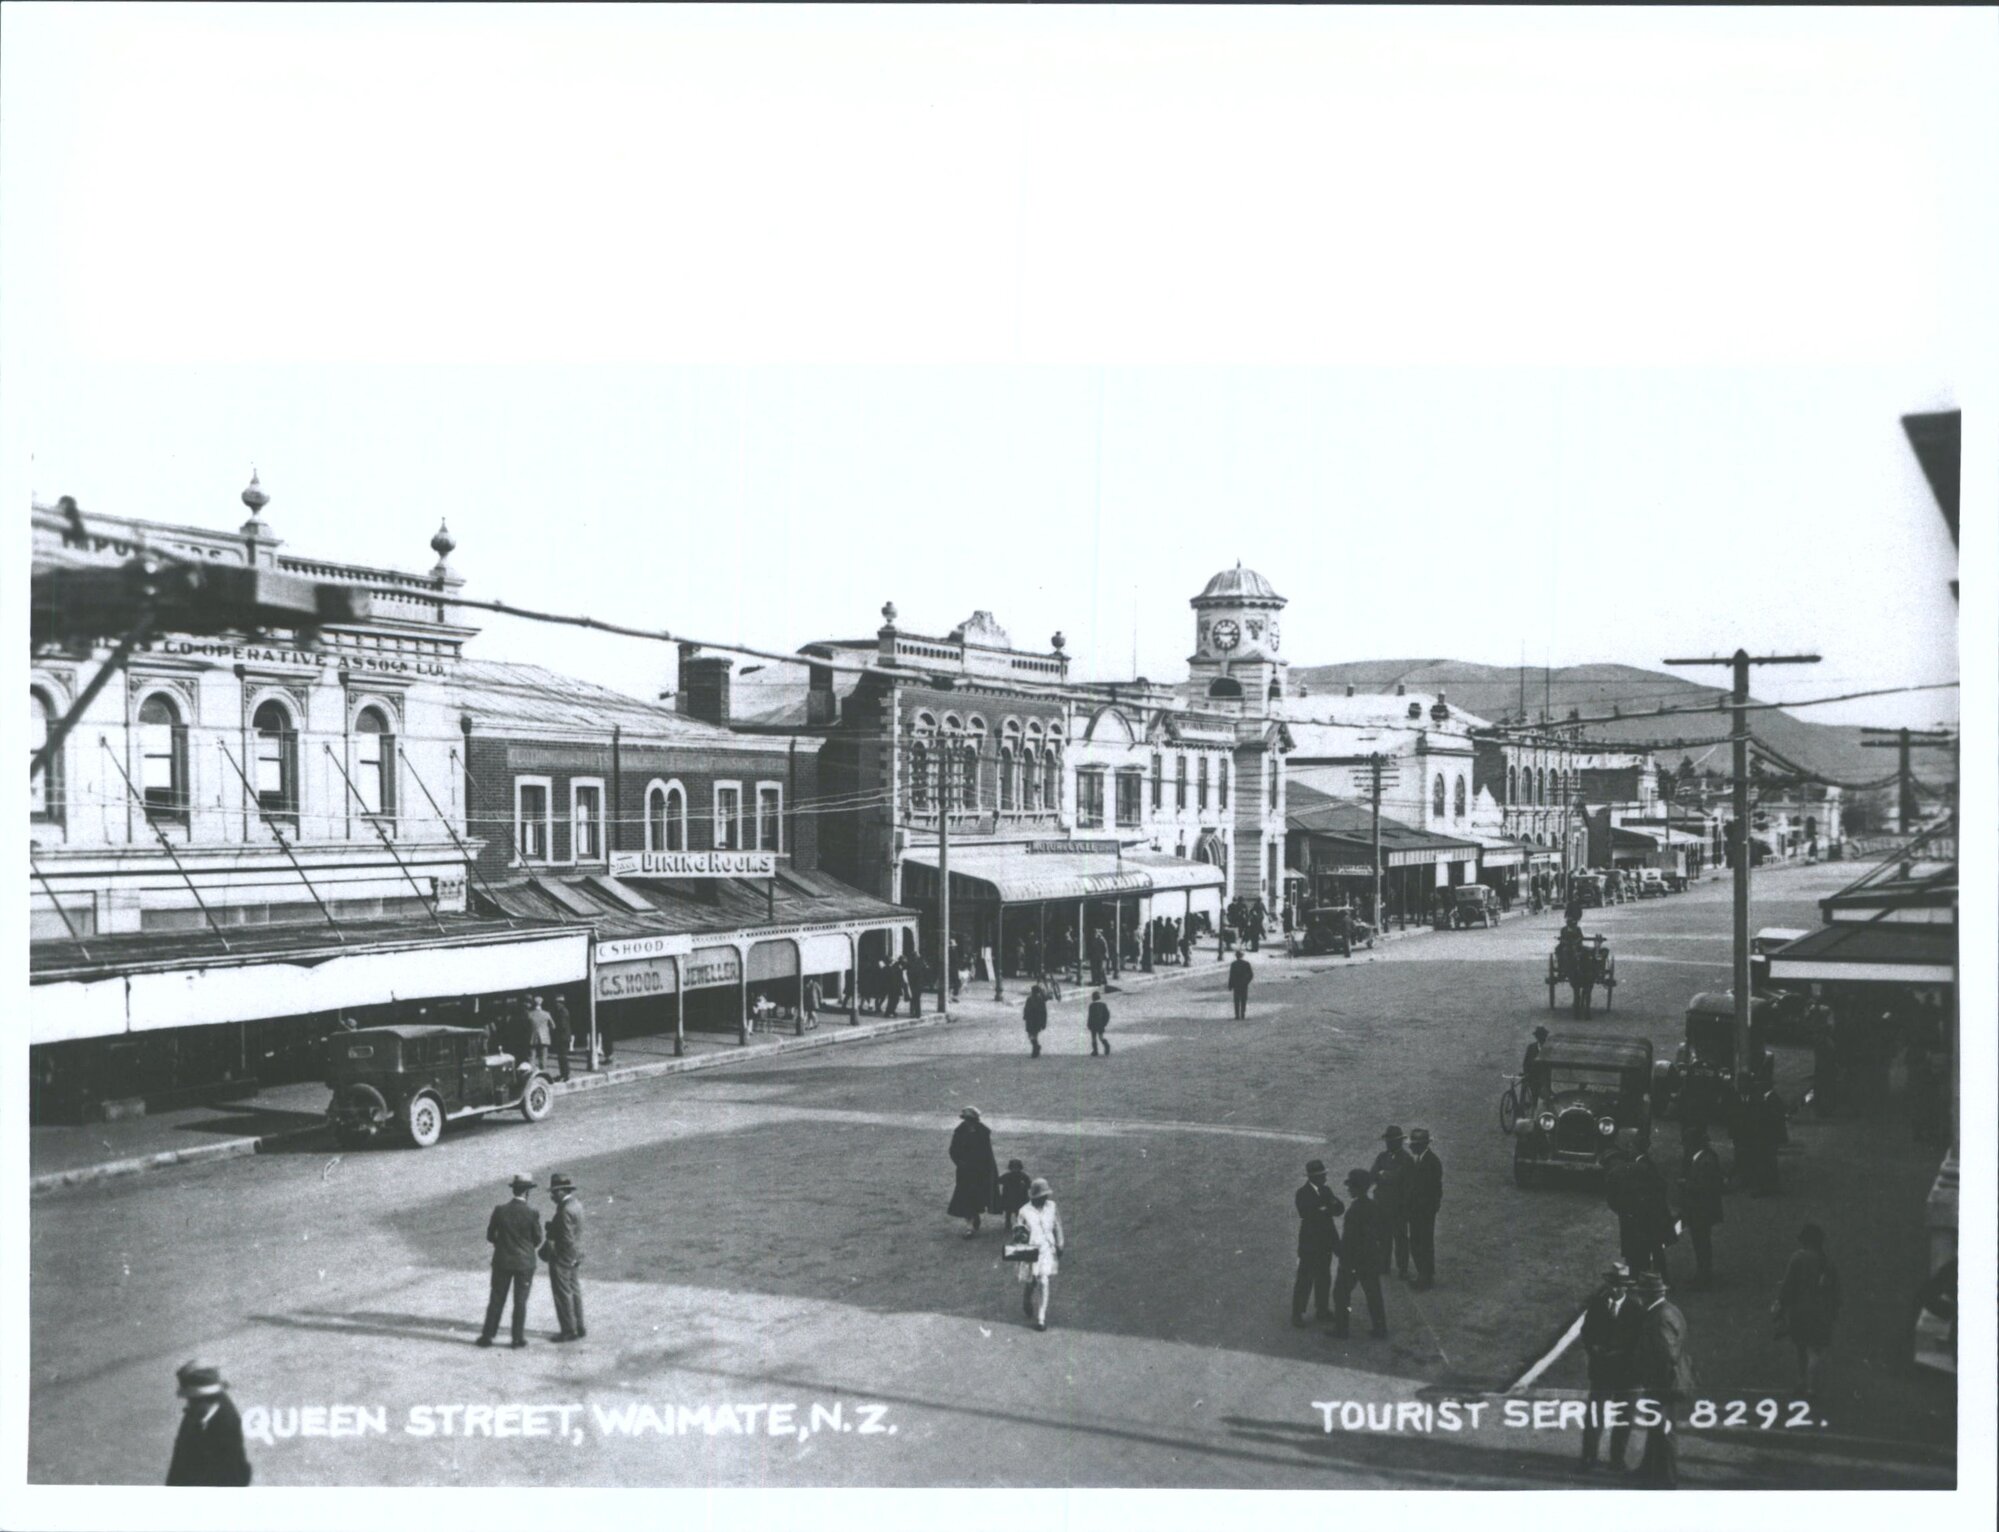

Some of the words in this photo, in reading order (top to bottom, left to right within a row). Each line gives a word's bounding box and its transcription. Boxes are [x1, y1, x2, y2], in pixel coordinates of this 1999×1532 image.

[163, 640, 327, 666] CO-OPERATIVE
[641, 852, 705, 873] DINING
[708, 852, 771, 873] ROOMS
